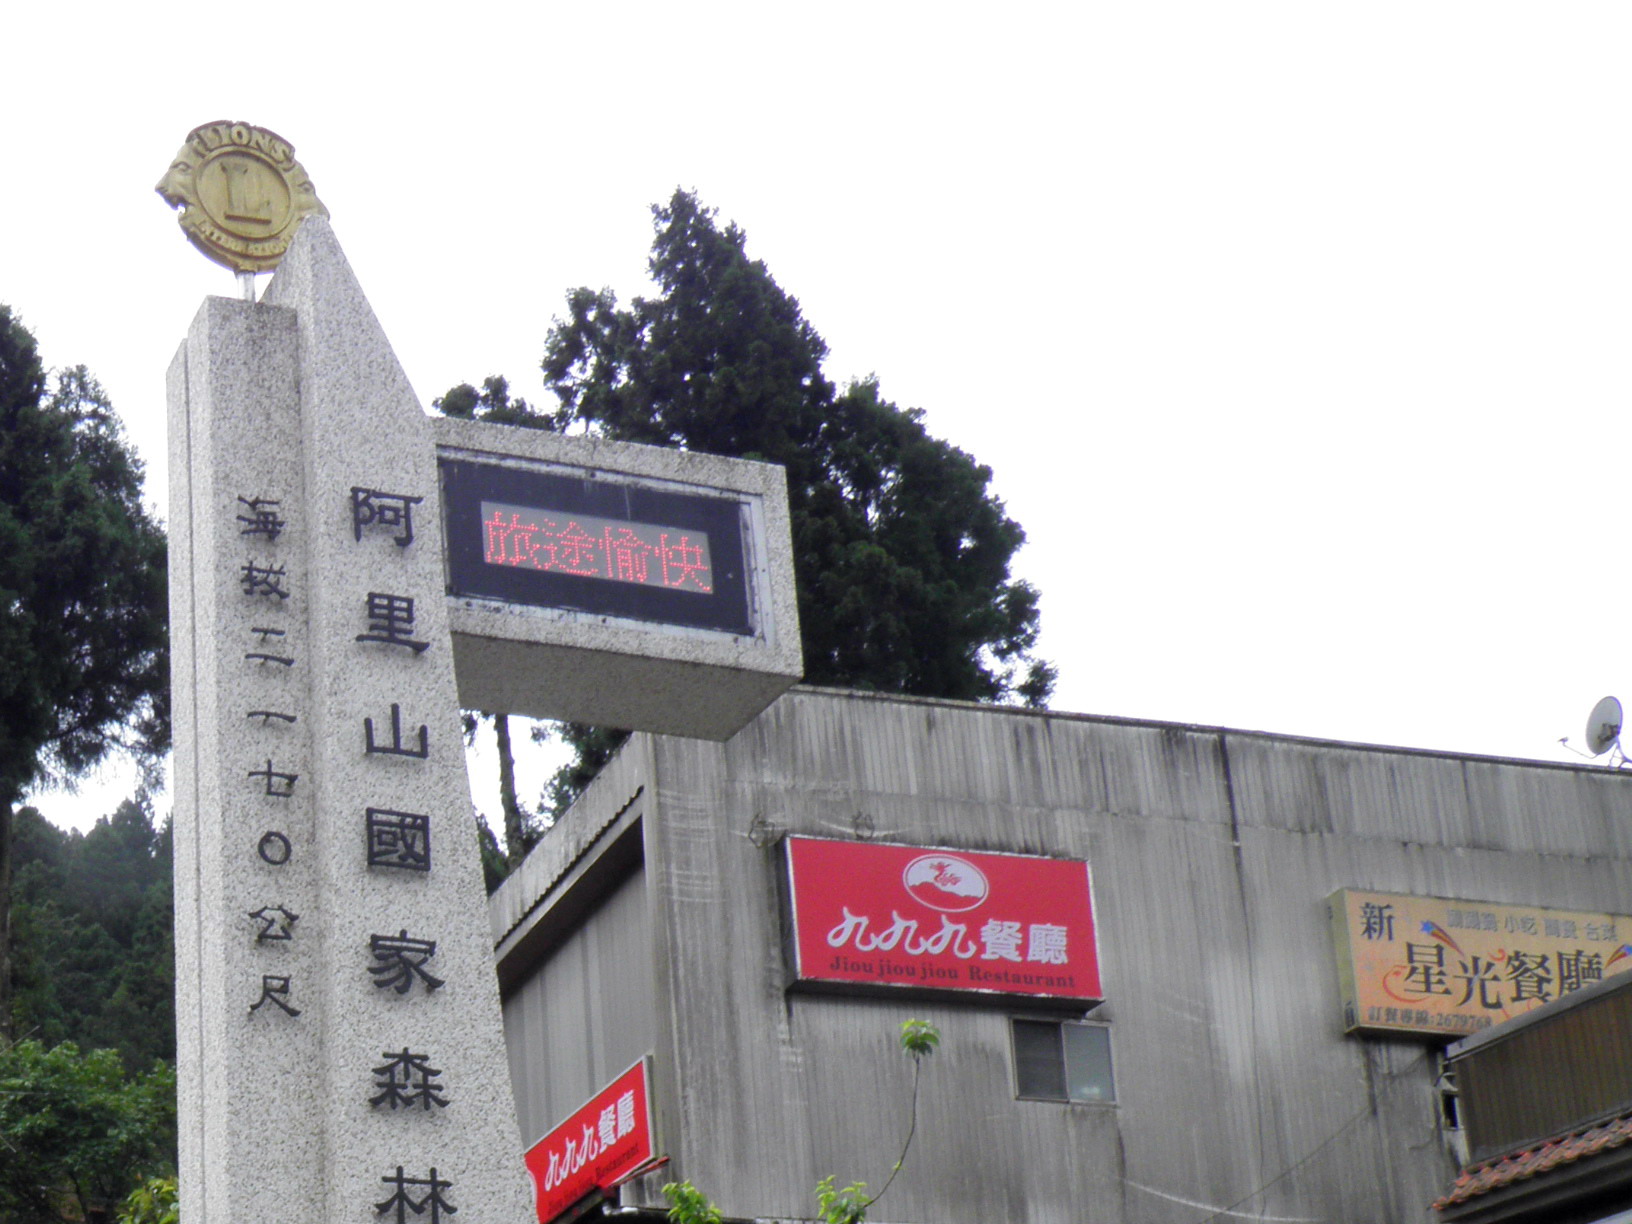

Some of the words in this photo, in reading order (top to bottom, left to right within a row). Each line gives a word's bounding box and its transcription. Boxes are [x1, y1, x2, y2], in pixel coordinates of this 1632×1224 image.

[484, 511, 711, 591] 旅途愉快
[827, 906, 1069, 966] 九九九餐廳
[1359, 902, 1395, 941] 新
[969, 965, 1076, 988] Restaurant
[1403, 942, 1603, 1009] 星光餐廳
